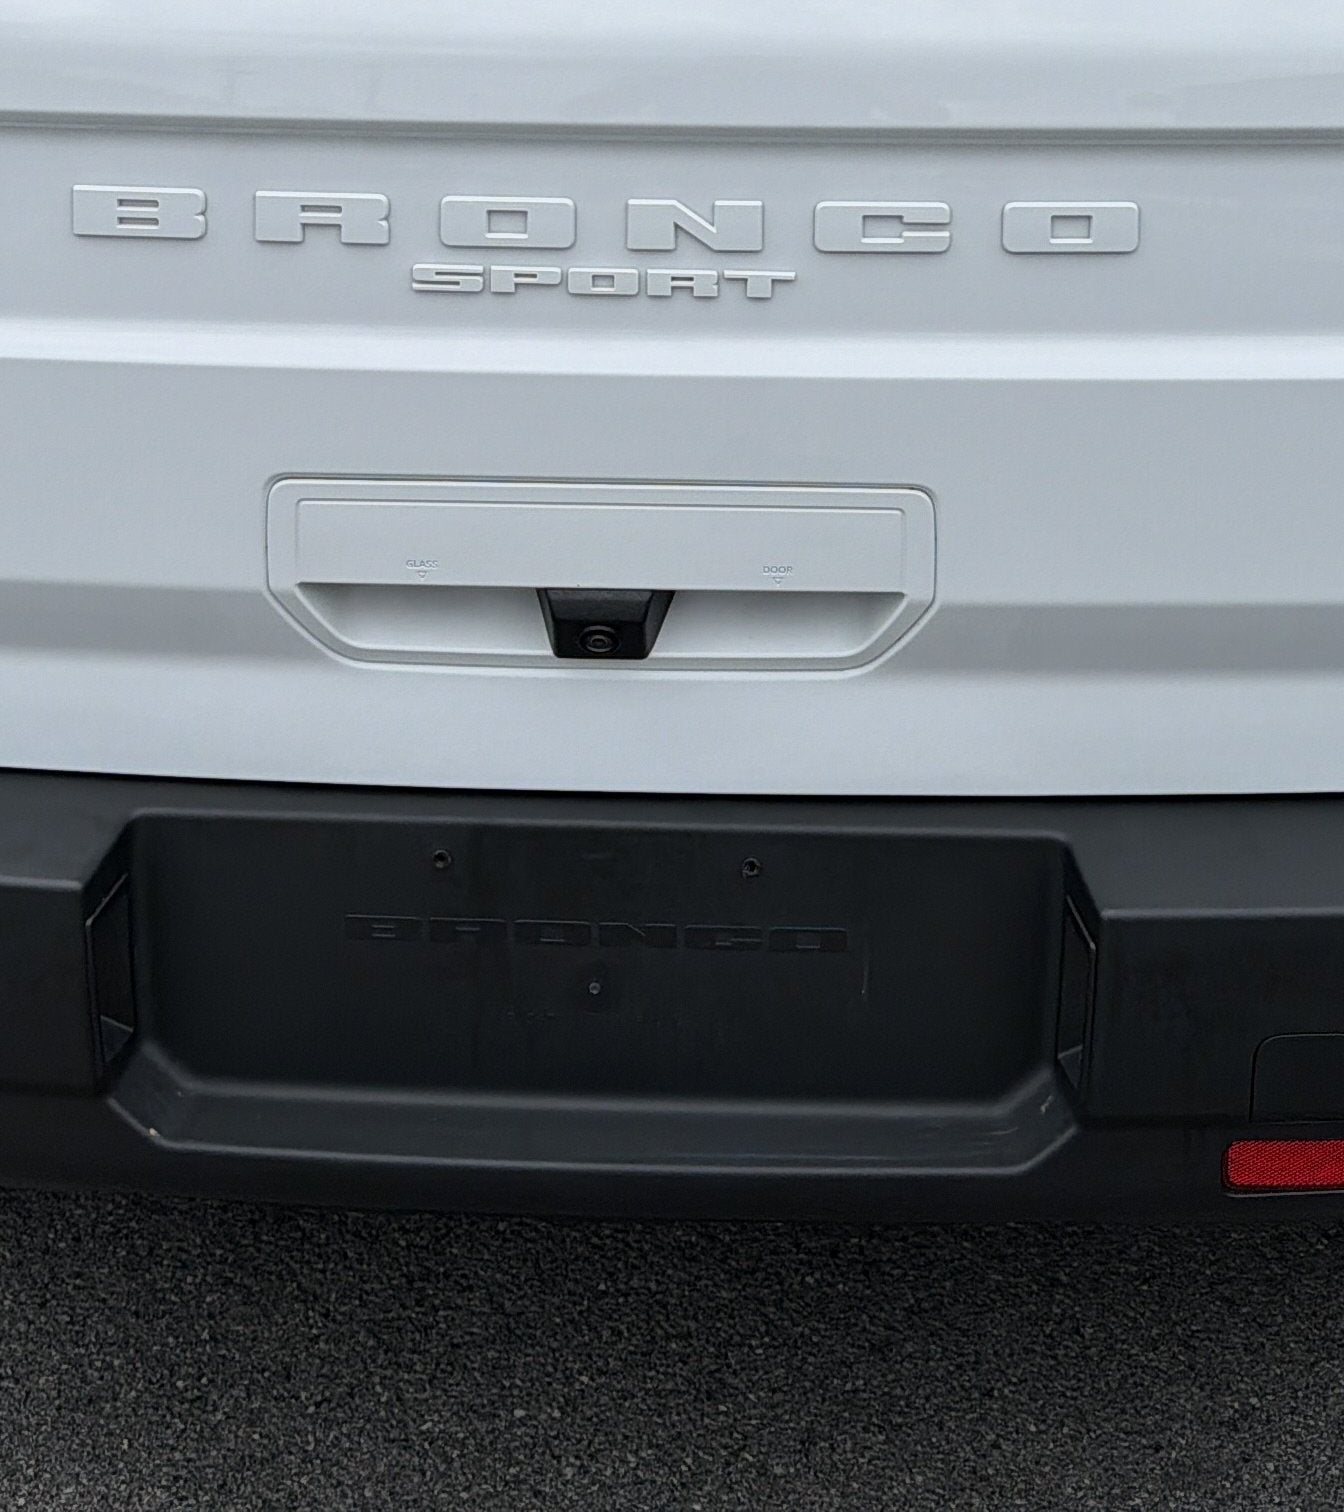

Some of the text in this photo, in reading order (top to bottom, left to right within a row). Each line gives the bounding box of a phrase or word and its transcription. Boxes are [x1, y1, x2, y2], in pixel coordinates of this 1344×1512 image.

[72, 185, 1141, 255] BRONCO
[411, 261, 796, 300] SPORT
[406, 559, 438, 569] GLASS
[762, 565, 793, 575] DOOR
[344, 913, 848, 953] BRONCO
